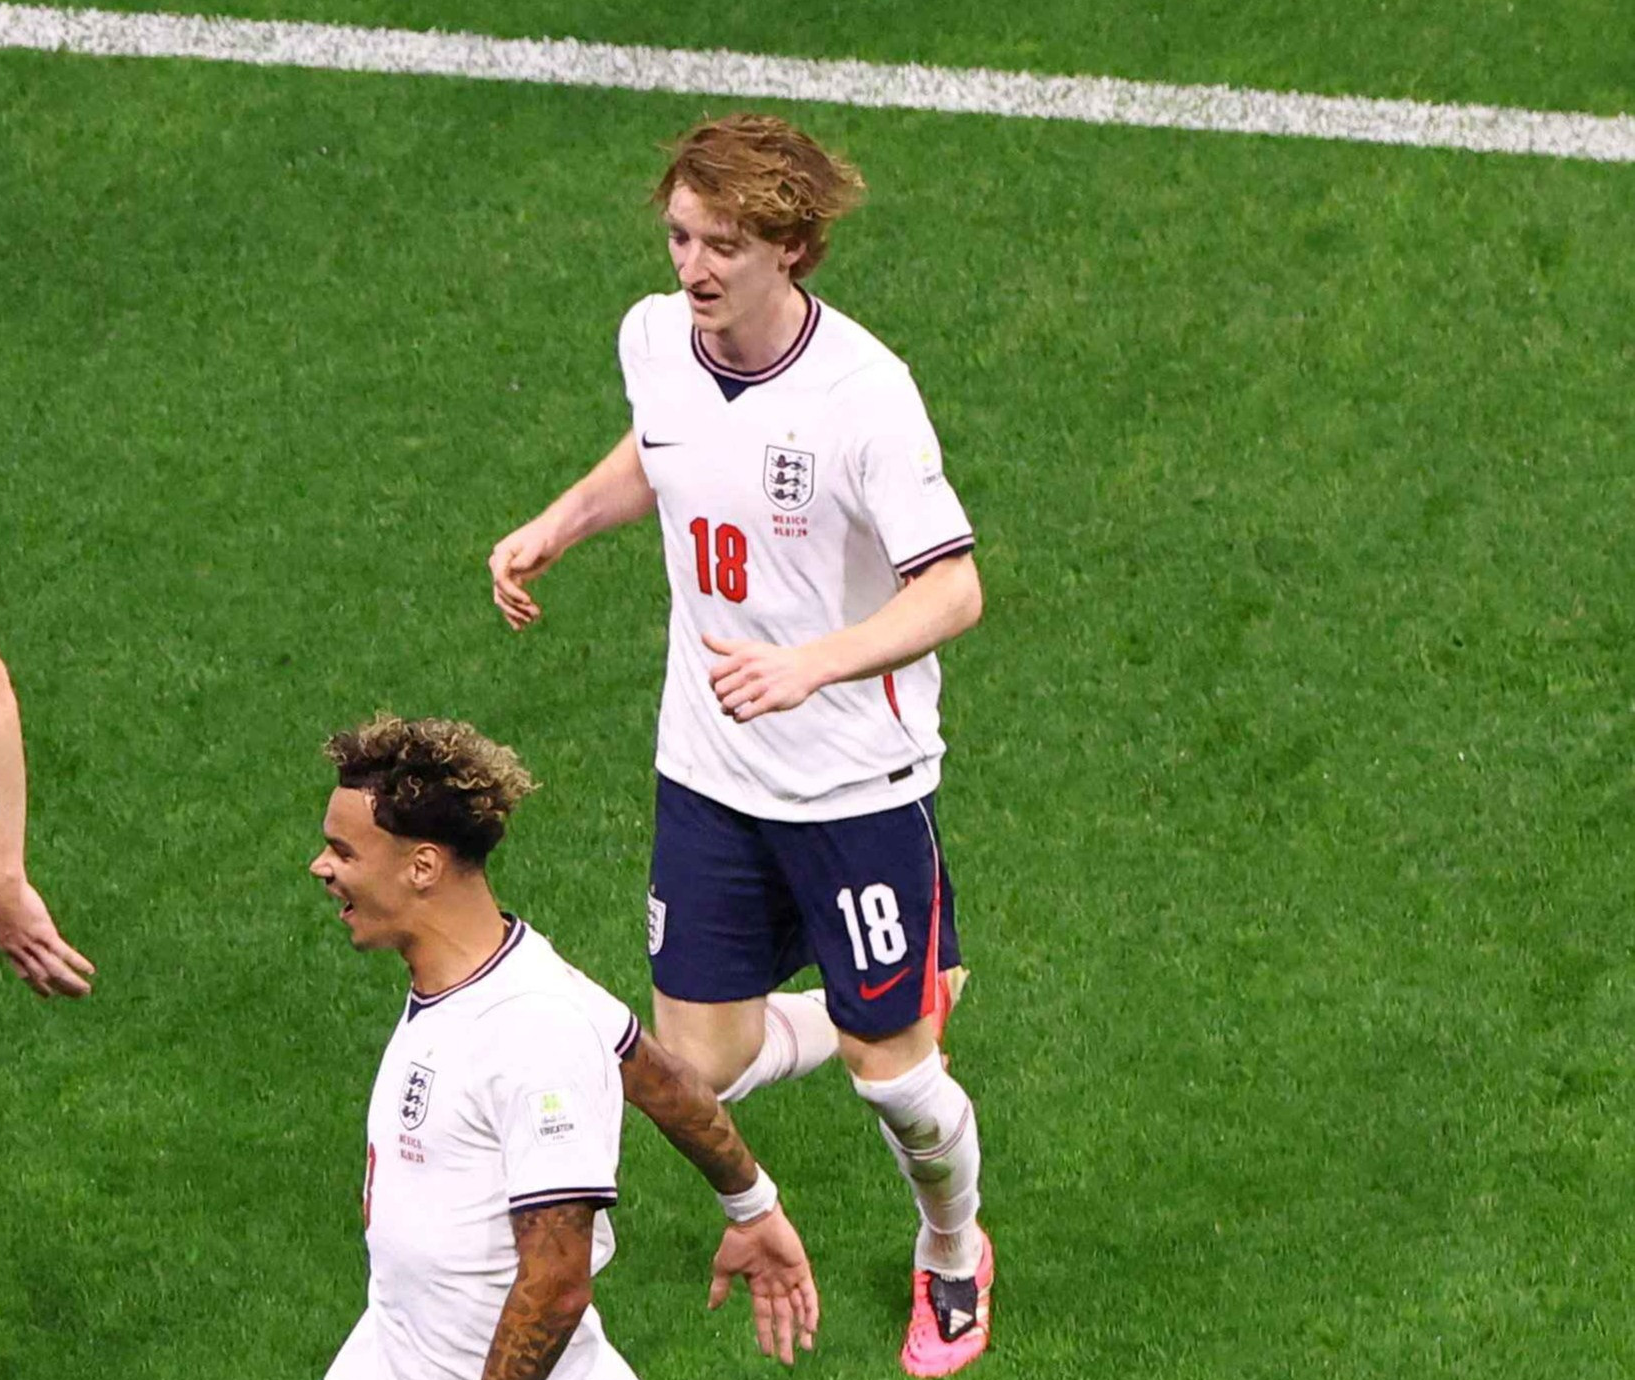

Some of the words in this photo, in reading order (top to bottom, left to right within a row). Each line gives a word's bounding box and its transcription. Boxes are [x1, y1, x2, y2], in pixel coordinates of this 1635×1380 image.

[689, 516, 747, 603] 18
[772, 514, 808, 525] MEXICO
[836, 883, 908, 970] 18
